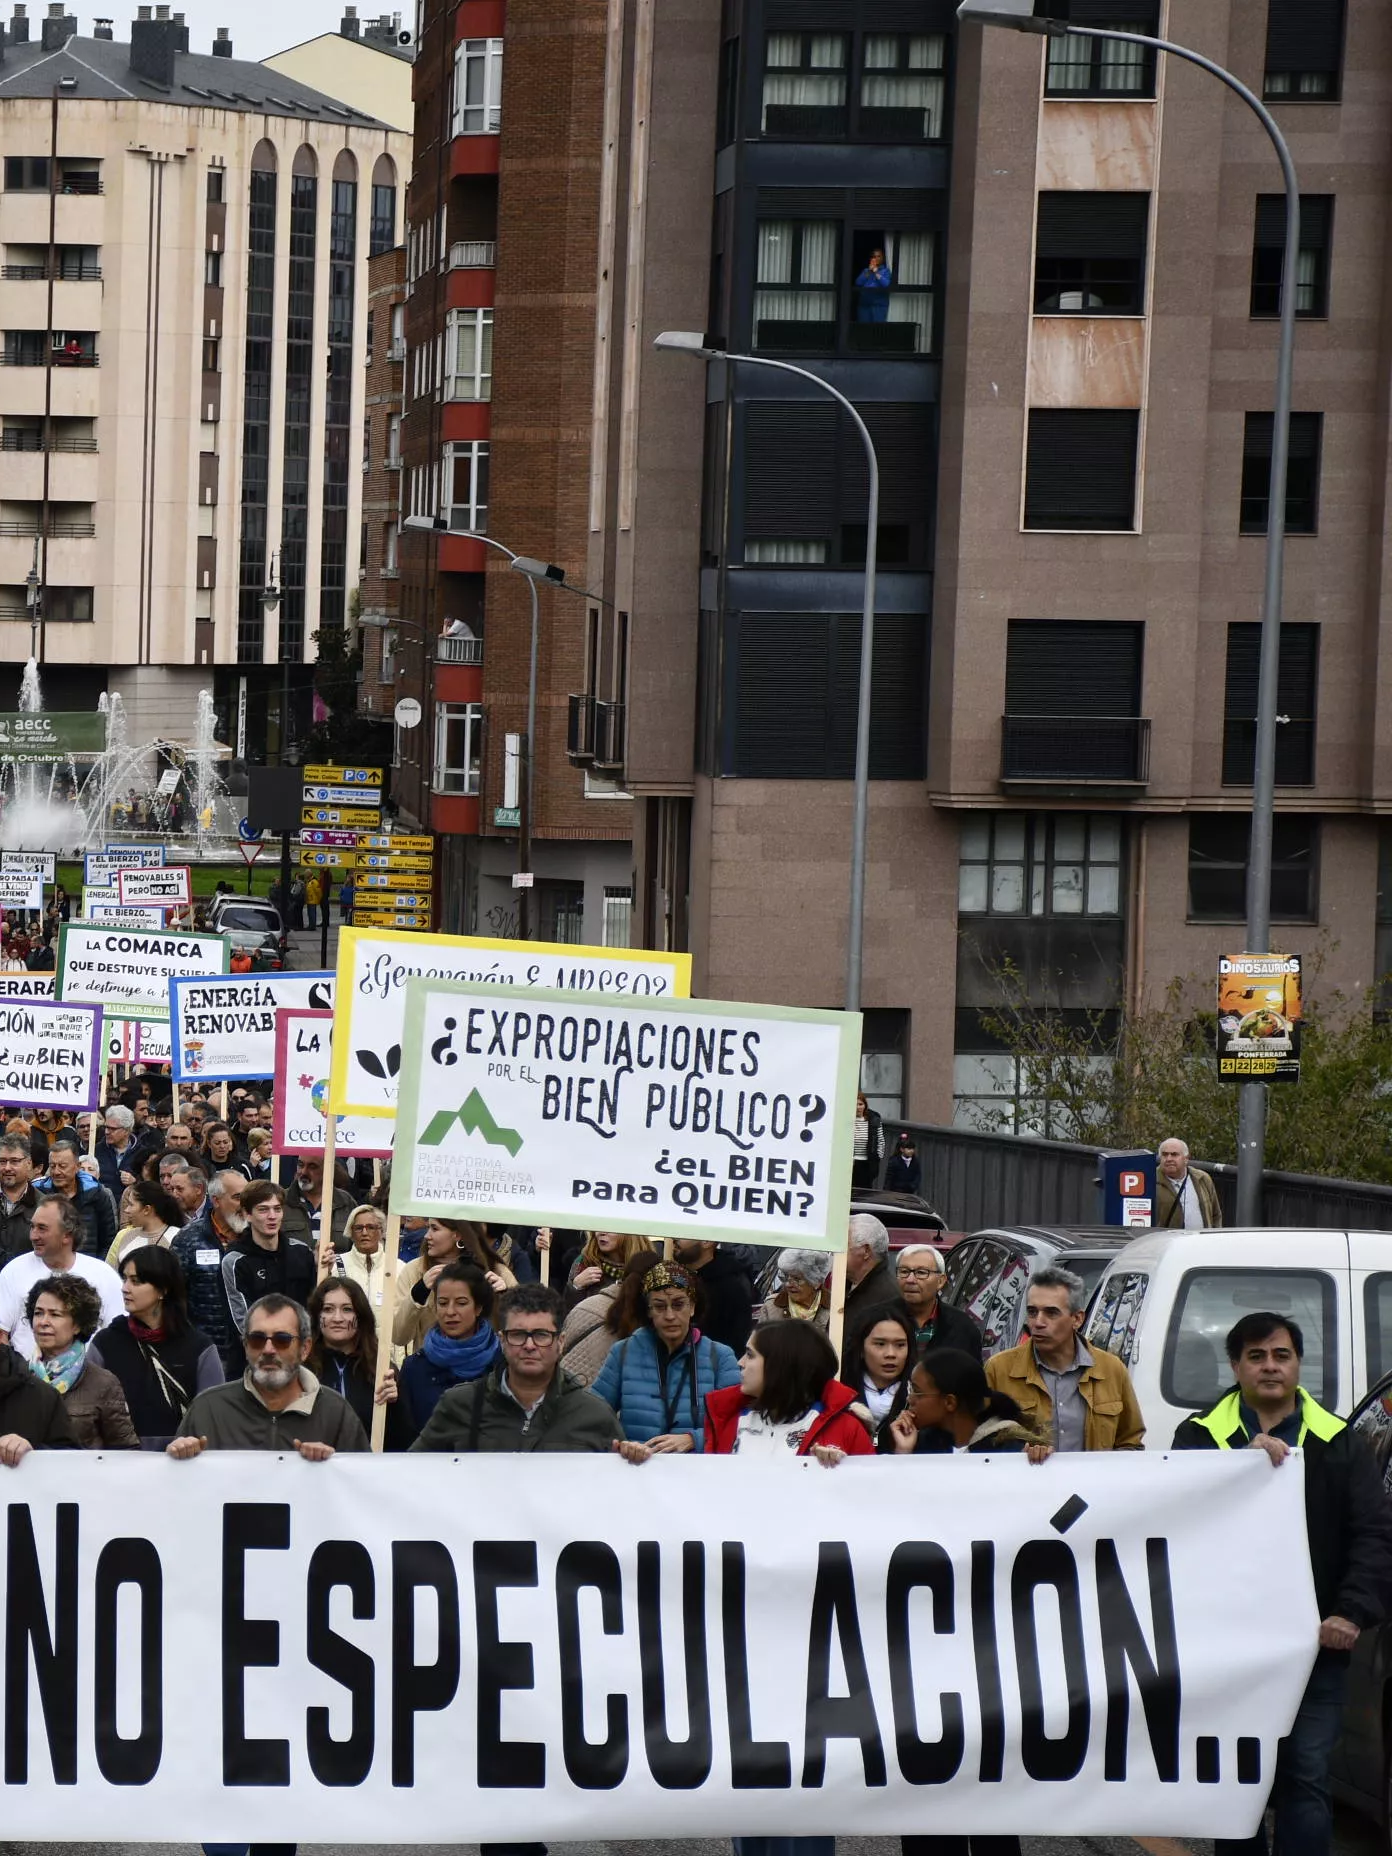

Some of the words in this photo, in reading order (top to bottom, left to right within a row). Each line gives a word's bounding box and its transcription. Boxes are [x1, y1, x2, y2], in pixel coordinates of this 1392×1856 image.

[14, 719, 51, 731] aecc
[0, 754, 15, 762] de
[17, 754, 64, 762] Octubre
[391, 837, 407, 846] hotel
[408, 840, 430, 848] Temple
[7, 882, 32, 890] VENDE
[123, 873, 175, 882] RENOVABLES
[176, 871, 184, 881] SÍ
[128, 886, 150, 895] PERO
[151, 885, 163, 895] NO
[164, 883, 178, 894] ASÍ
[103, 908, 113, 916] EL
[86, 940, 101, 951] LA
[105, 936, 203, 959] COMARCA
[69, 960, 94, 972] QUE
[97, 962, 157, 977] DESTRUYE
[160, 967, 176, 977] SU
[1219, 958, 1300, 974] DINOSAURIOS
[67, 980, 80, 992] se
[85, 978, 142, 998] destruye
[183, 981, 277, 1013] ¿ENERGÍA
[295, 1028, 321, 1053] LA
[431, 1007, 761, 1078] ¿EXPROPIACIONES
[36, 1047, 85, 1068] BIEN
[1237, 1050, 1288, 1058] PONFERRADA
[487, 1062, 515, 1082] POR
[519, 1065, 542, 1084] EL
[1222, 1062, 1233, 1070] 21
[1237, 1062, 1249, 1070] 22
[1252, 1062, 1264, 1070] 28
[1265, 1062, 1276, 1070] 29
[5, 1070, 84, 1094] QUIEN?
[542, 1065, 634, 1139] BIEN
[288, 1124, 356, 1144] cedce
[418, 1152, 502, 1169] PLATAFORMA
[727, 1154, 816, 1187] BIEN
[418, 1164, 450, 1176] PARA
[455, 1168, 471, 1179] LA
[474, 1169, 534, 1184] DEFENSA
[1124, 1174, 1139, 1193] P
[417, 1175, 433, 1187] DE
[437, 1177, 452, 1189] LA
[457, 1179, 536, 1196] CORDILLERA
[671, 1181, 816, 1218] QUIEN?
[4, 1502, 164, 1787] NO
